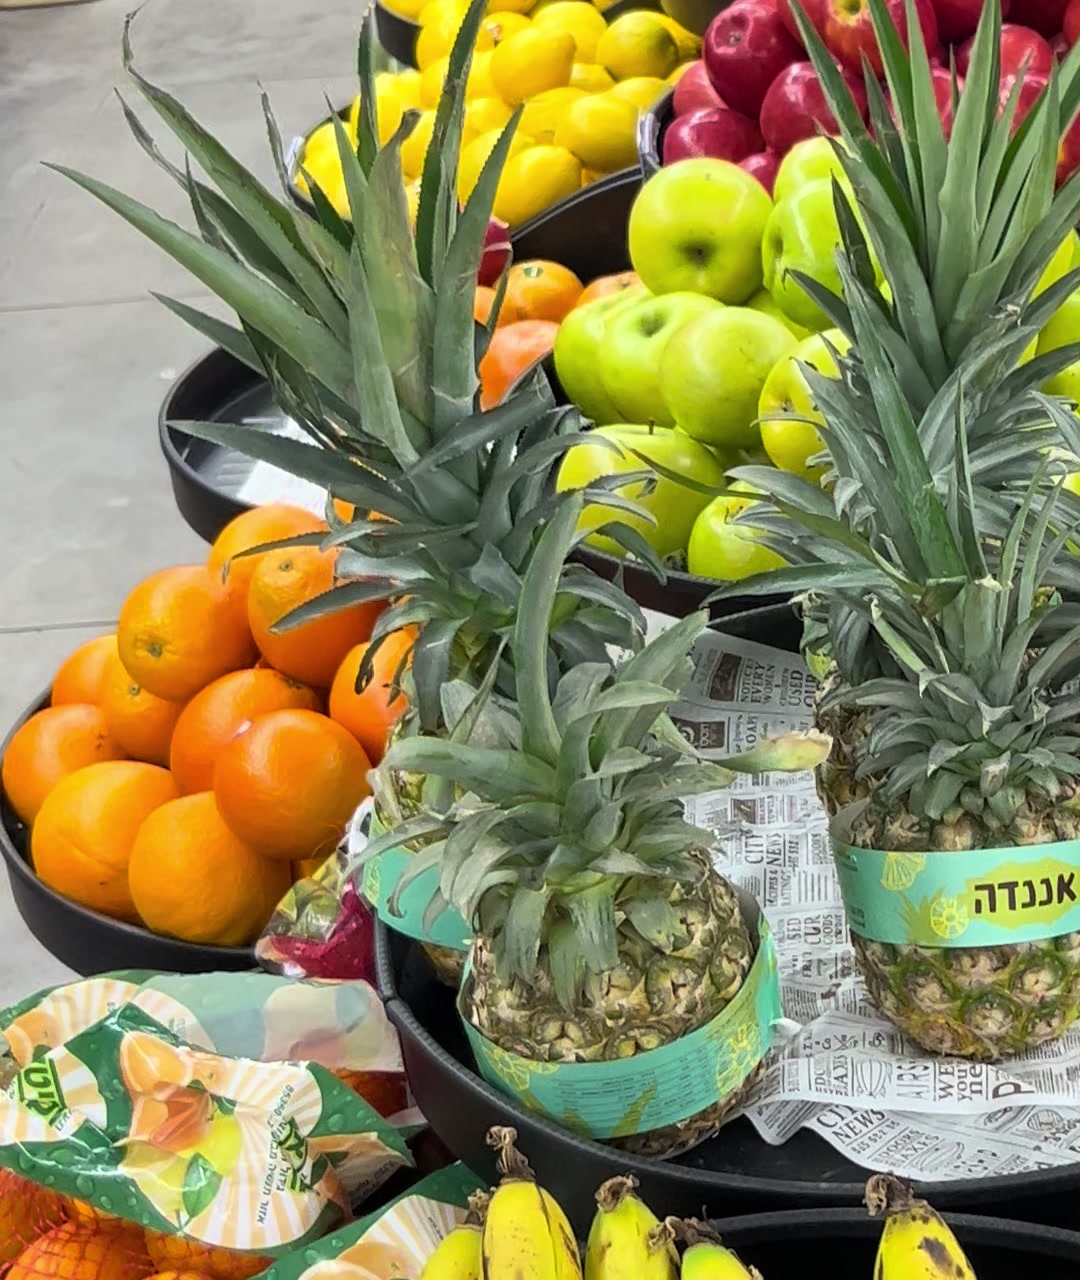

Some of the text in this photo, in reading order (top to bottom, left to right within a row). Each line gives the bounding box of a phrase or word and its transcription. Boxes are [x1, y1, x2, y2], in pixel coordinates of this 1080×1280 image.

[750, 661, 766, 704] EVERY
[788, 670, 804, 707] USED
[745, 832, 764, 864] CITY
[766, 832, 782, 867] NEWS
[974, 872, 1077, 914] אננדה
[832, 1108, 886, 1145] NEWS
